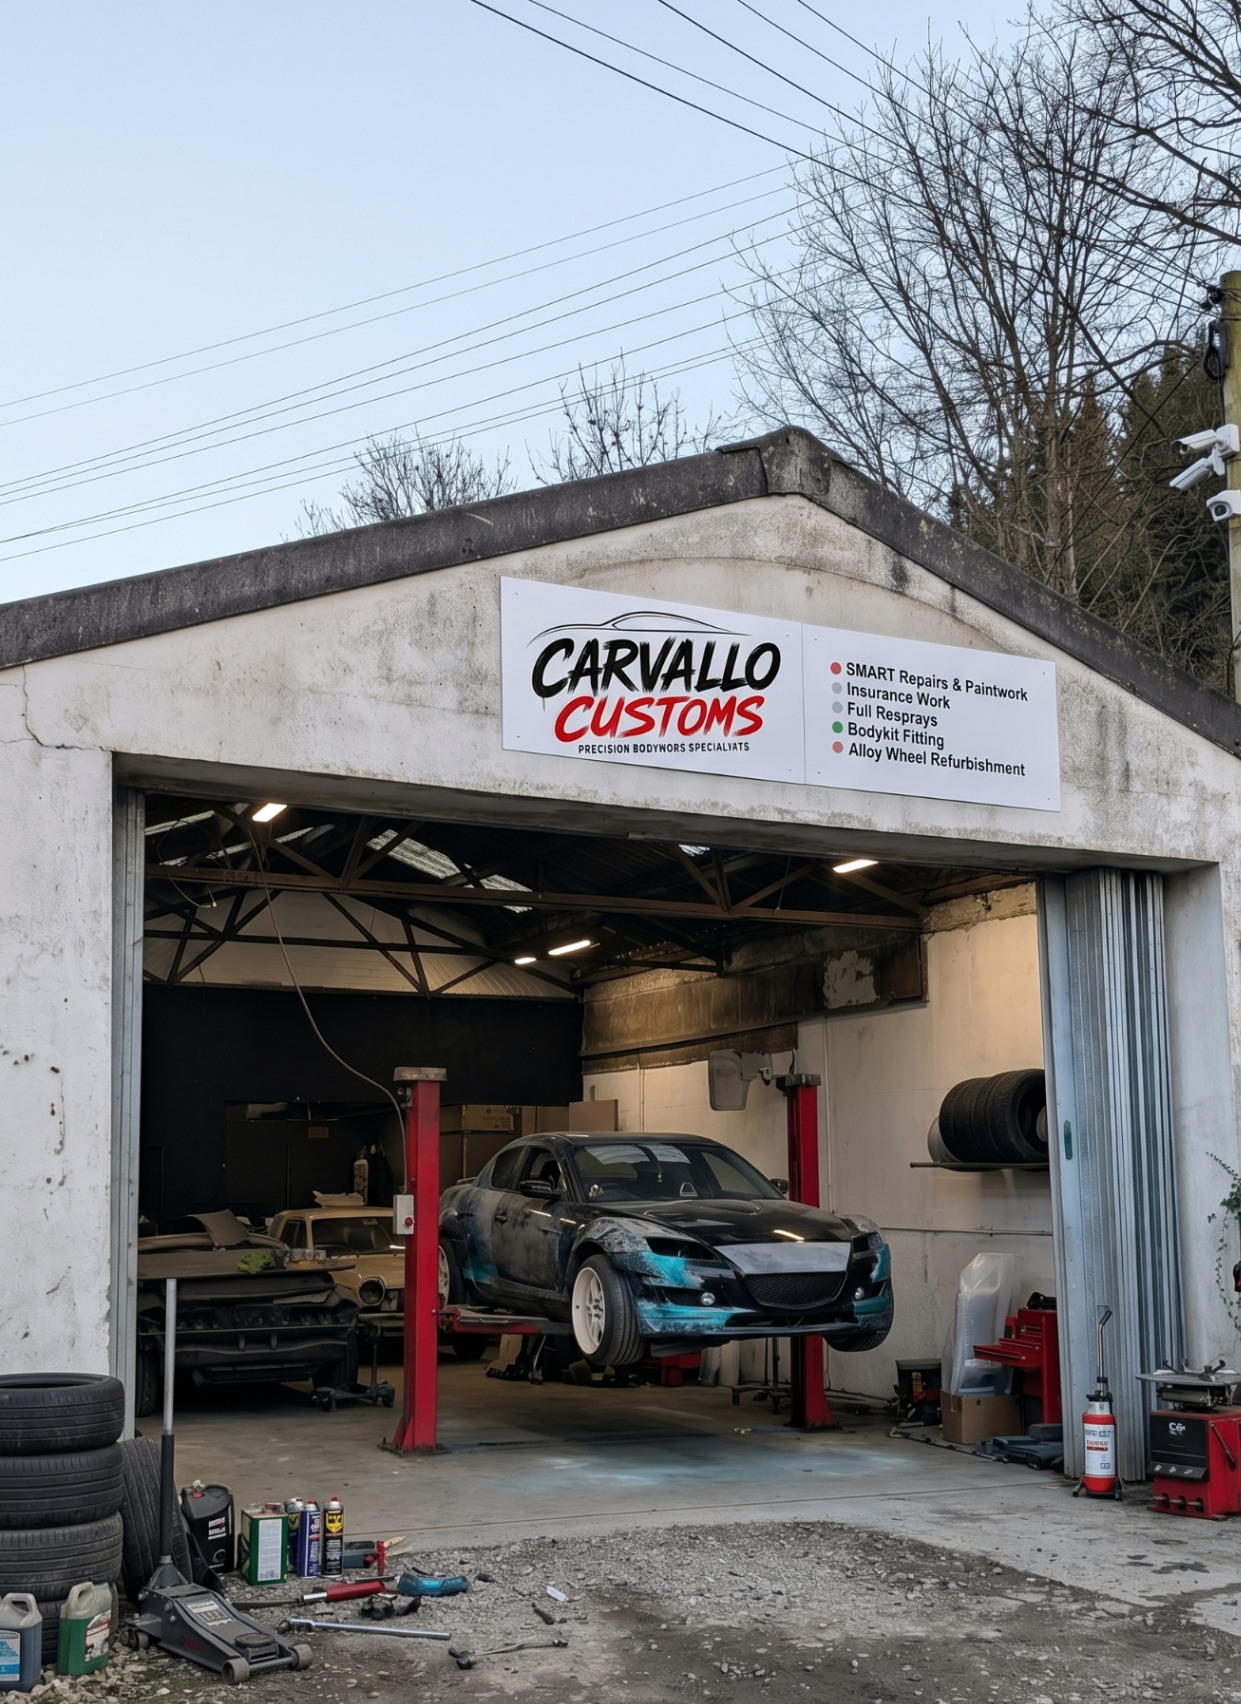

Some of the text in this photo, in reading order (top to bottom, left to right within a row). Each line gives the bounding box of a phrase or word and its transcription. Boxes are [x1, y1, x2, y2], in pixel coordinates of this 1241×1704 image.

[532, 636, 781, 698] CARVALLO
[846, 662, 1028, 701] SMART Repairs & Paintwork
[847, 682, 951, 709] Insurance Work
[554, 695, 765, 742] CUSTOMS
[847, 702, 938, 728] Full Resprays
[578, 744, 630, 754] PRECISION
[633, 743, 686, 753] BODYWORS
[847, 722, 945, 750] Bodykit Fitting
[848, 743, 1026, 776] Alloy Wheel Refurbishment
